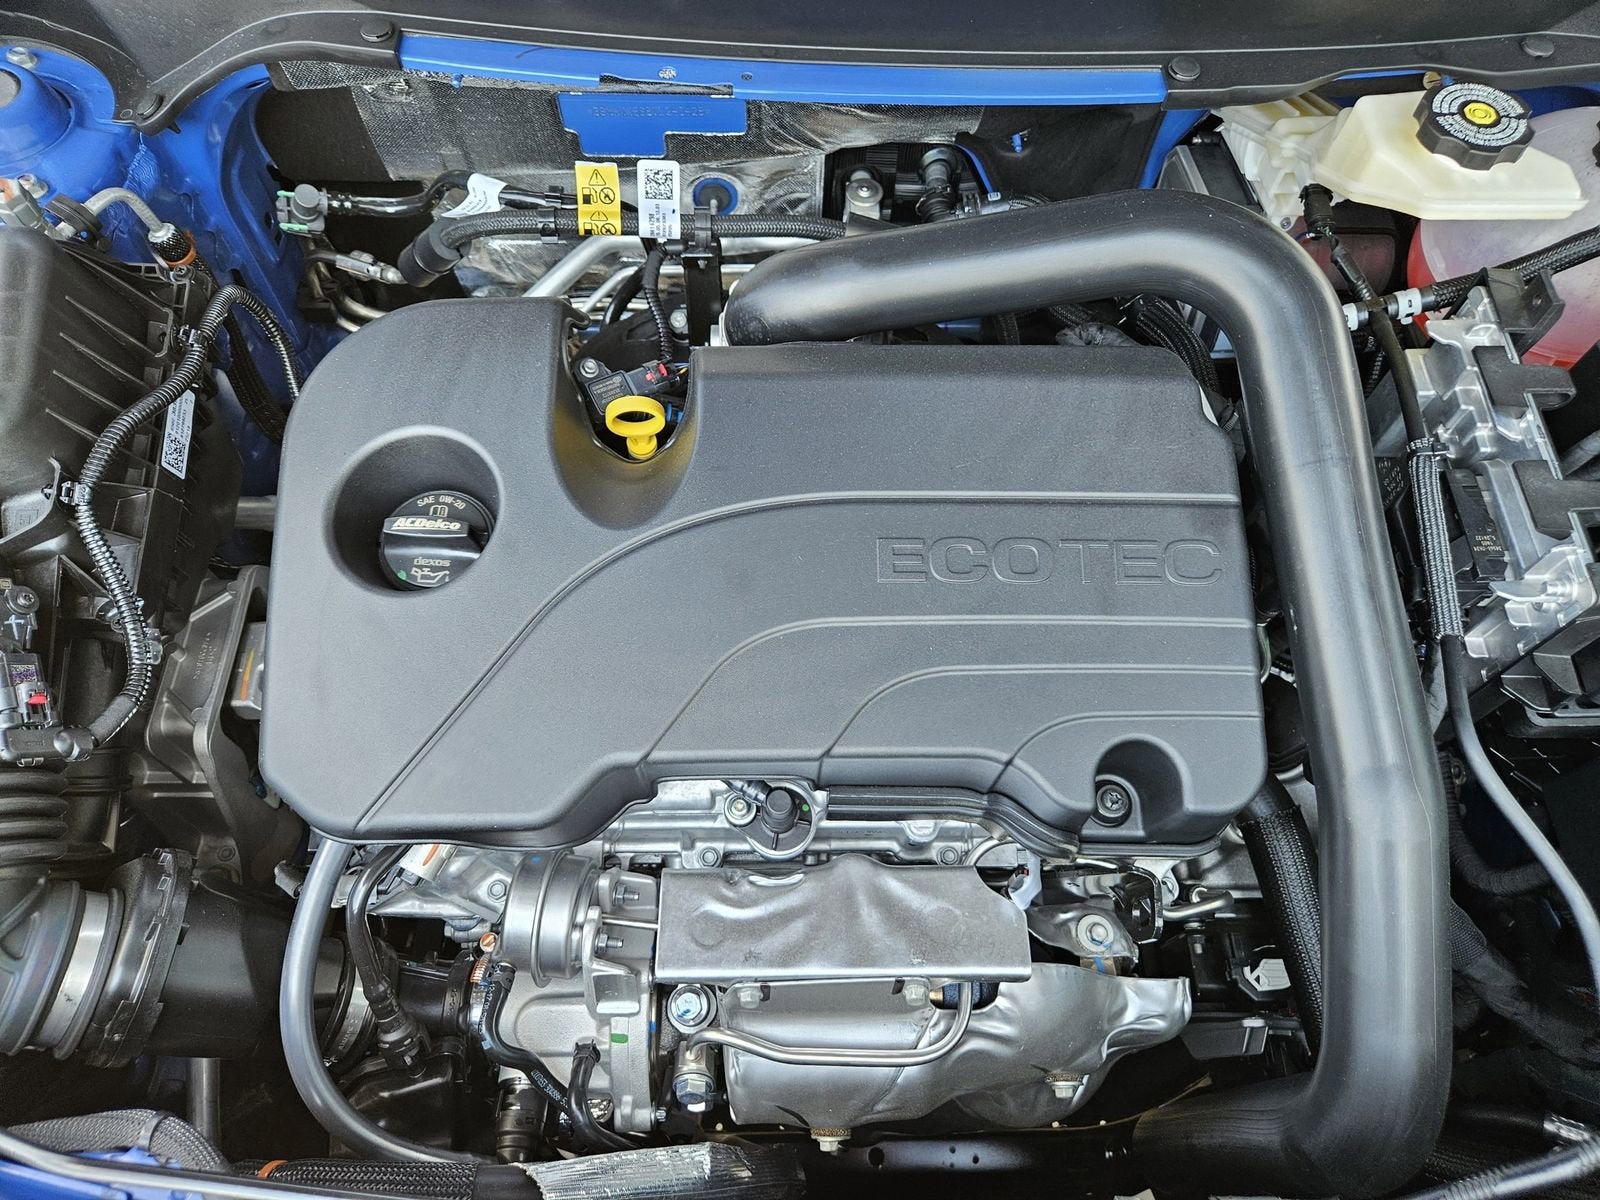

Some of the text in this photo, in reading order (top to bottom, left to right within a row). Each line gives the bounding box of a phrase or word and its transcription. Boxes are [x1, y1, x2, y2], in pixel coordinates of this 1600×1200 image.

[417, 495, 466, 509] SAE 0W-20
[392, 517, 462, 531] ACDelco
[413, 556, 452, 566] dexos
[876, 536, 1224, 585] ECOTEC
